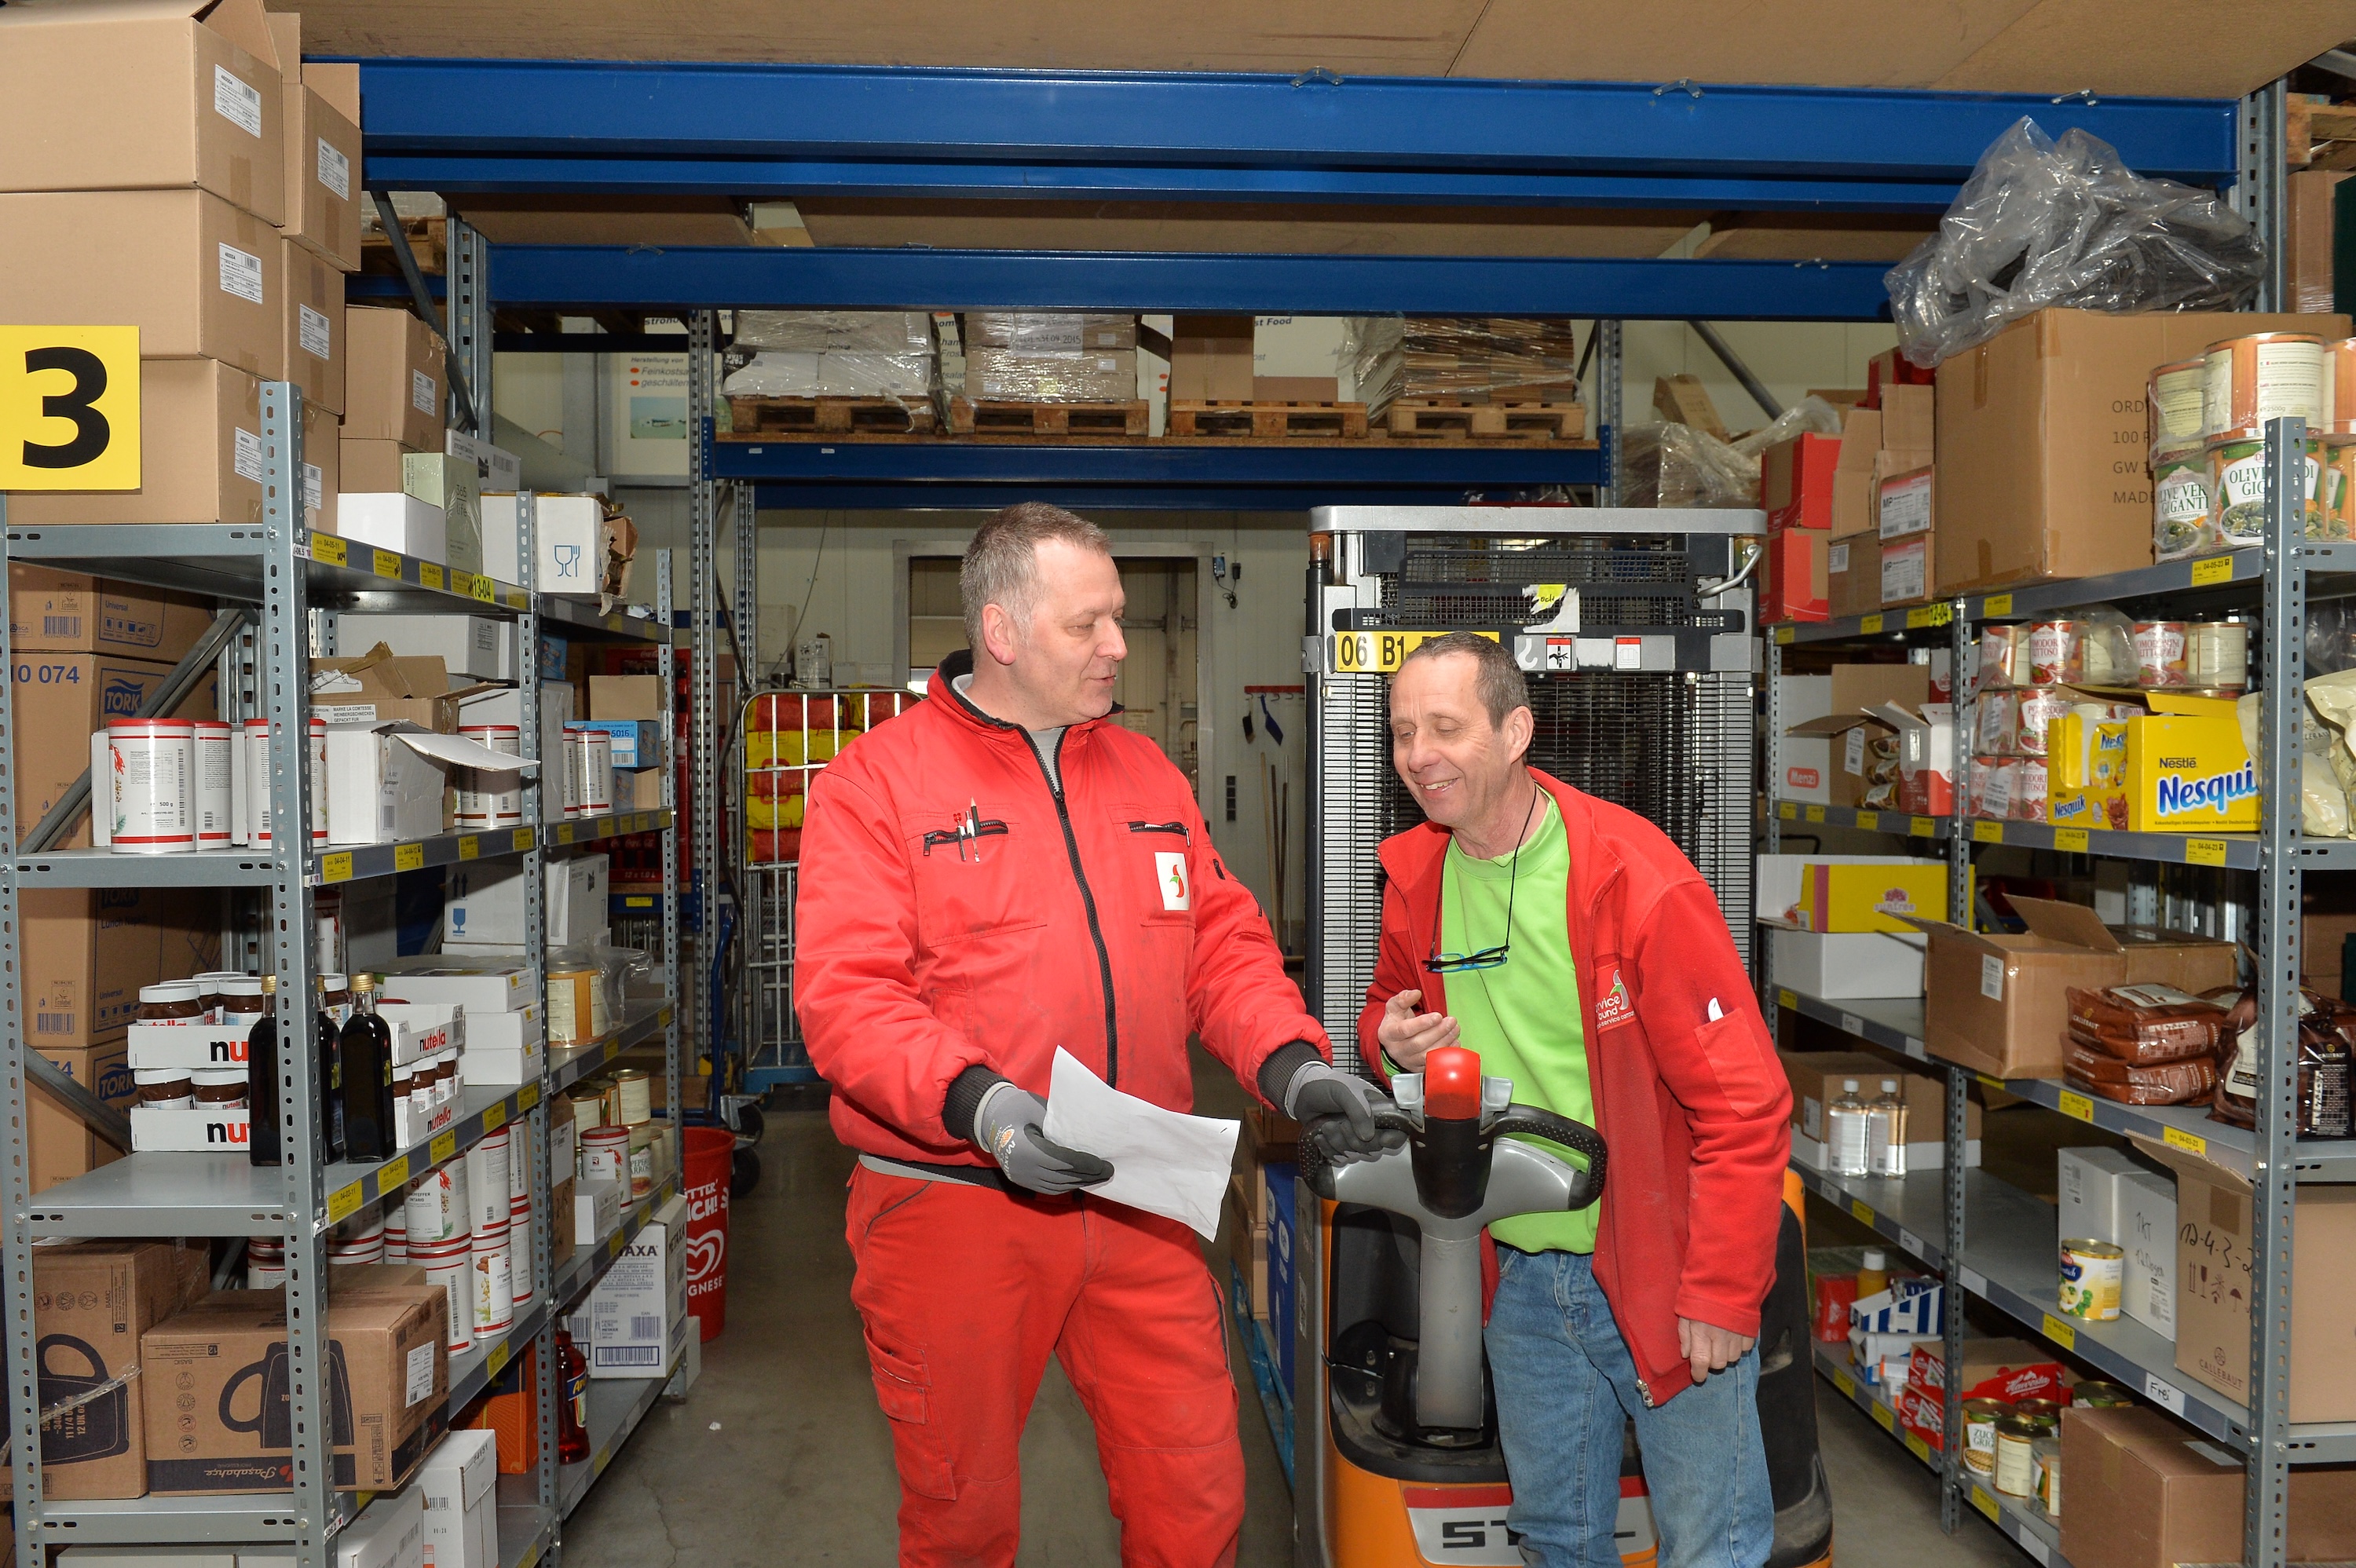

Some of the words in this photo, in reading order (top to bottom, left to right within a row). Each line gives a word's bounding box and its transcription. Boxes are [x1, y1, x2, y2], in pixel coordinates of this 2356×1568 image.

[1267, 317, 1292, 326] Food
[1063, 335, 1081, 344] 2015
[642, 367, 689, 375] Feinkostsa
[22, 346, 110, 468] 3
[2113, 400, 2145, 413] ORD
[2113, 431, 2138, 444] 100
[2113, 462, 2138, 473] GW
[456, 484, 466, 498] 365
[2160, 486, 2179, 502] LIVE
[2182, 484, 2207, 497] VER
[324, 539, 340, 550] 04-05-11
[2203, 559, 2224, 571] 04-05-23
[474, 577, 491, 599] 13-04
[105, 599, 129, 612] Universal
[1341, 636, 1367, 666] 06
[1382, 636, 1405, 666] B1
[39, 666, 80, 684] 074
[107, 692, 141, 711] TORK
[2160, 760, 2260, 813] Nesqui
[2054, 795, 2086, 819] Nesquik
[2197, 842, 2219, 851] 04-04-23
[334, 857, 350, 865] 04-04-11
[101, 919, 122, 929] Lunch
[100, 988, 124, 1000] Universal
[1596, 995, 1620, 1013] rvice
[419, 1029, 446, 1052] nutella
[101, 1073, 134, 1098] TORK
[427, 1106, 452, 1133] nutella
[339, 1187, 356, 1201] 04-03-11
[622, 1245, 657, 1256] AXA
[688, 1276, 723, 1297] GNESE
[116, 1324, 124, 1332] 12
[209, 1346, 218, 1354] 12
[2200, 1358, 2244, 1387] CALLEBAUT
[2150, 1382, 2171, 1402] Frei
[76, 1414, 86, 1425] UK
[77, 1427, 86, 1435] 12
[1974, 1437, 1994, 1448] GRIG
